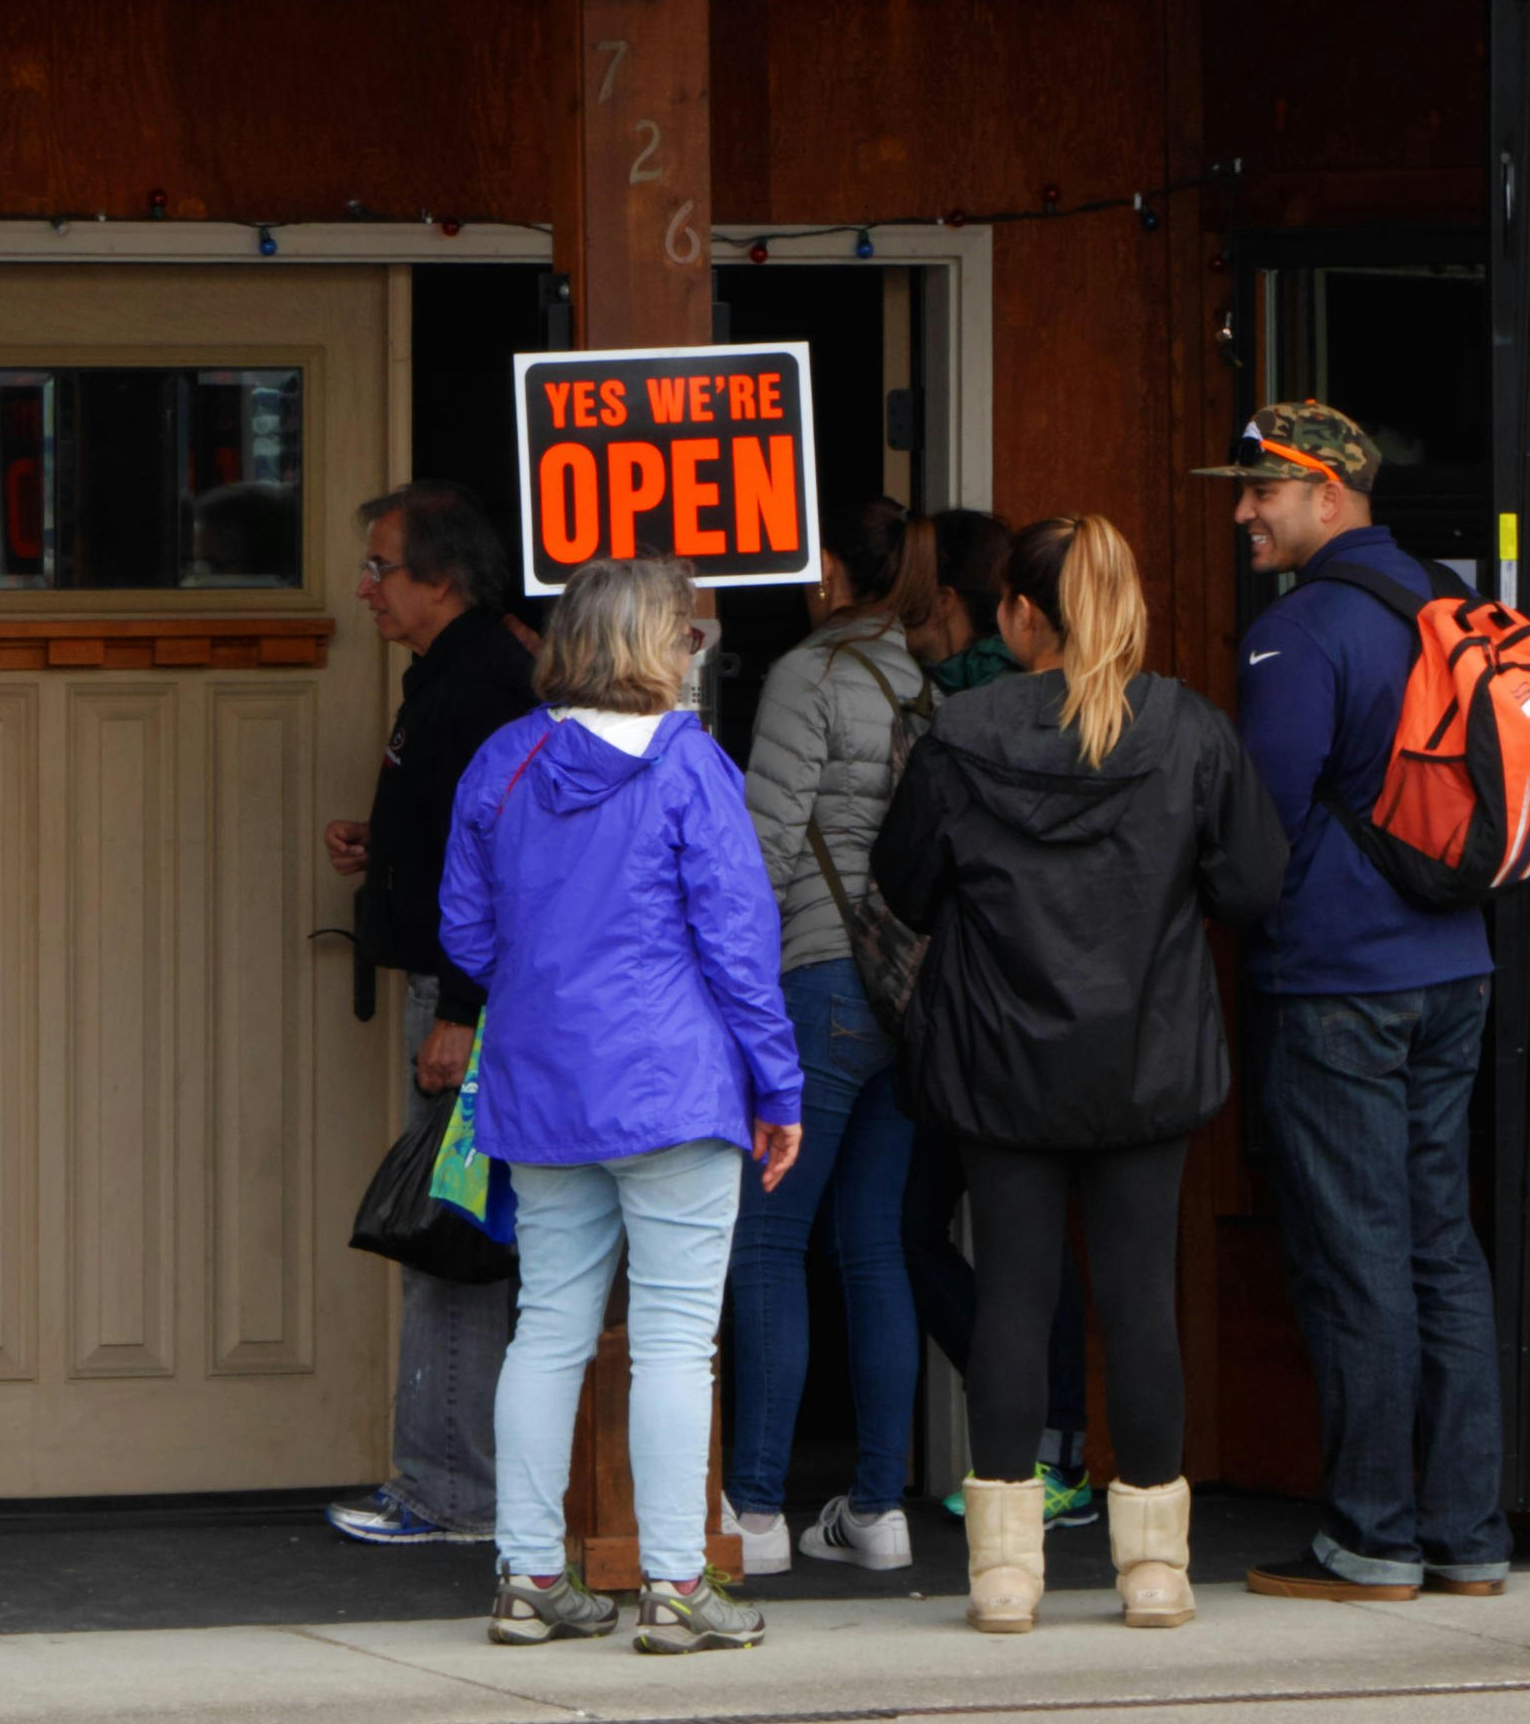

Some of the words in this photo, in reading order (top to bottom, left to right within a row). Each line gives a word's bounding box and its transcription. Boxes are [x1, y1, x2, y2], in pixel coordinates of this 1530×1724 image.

[544, 380, 628, 429] YES
[646, 373, 783, 424] WE'RE
[539, 435, 799, 564] OPEN
